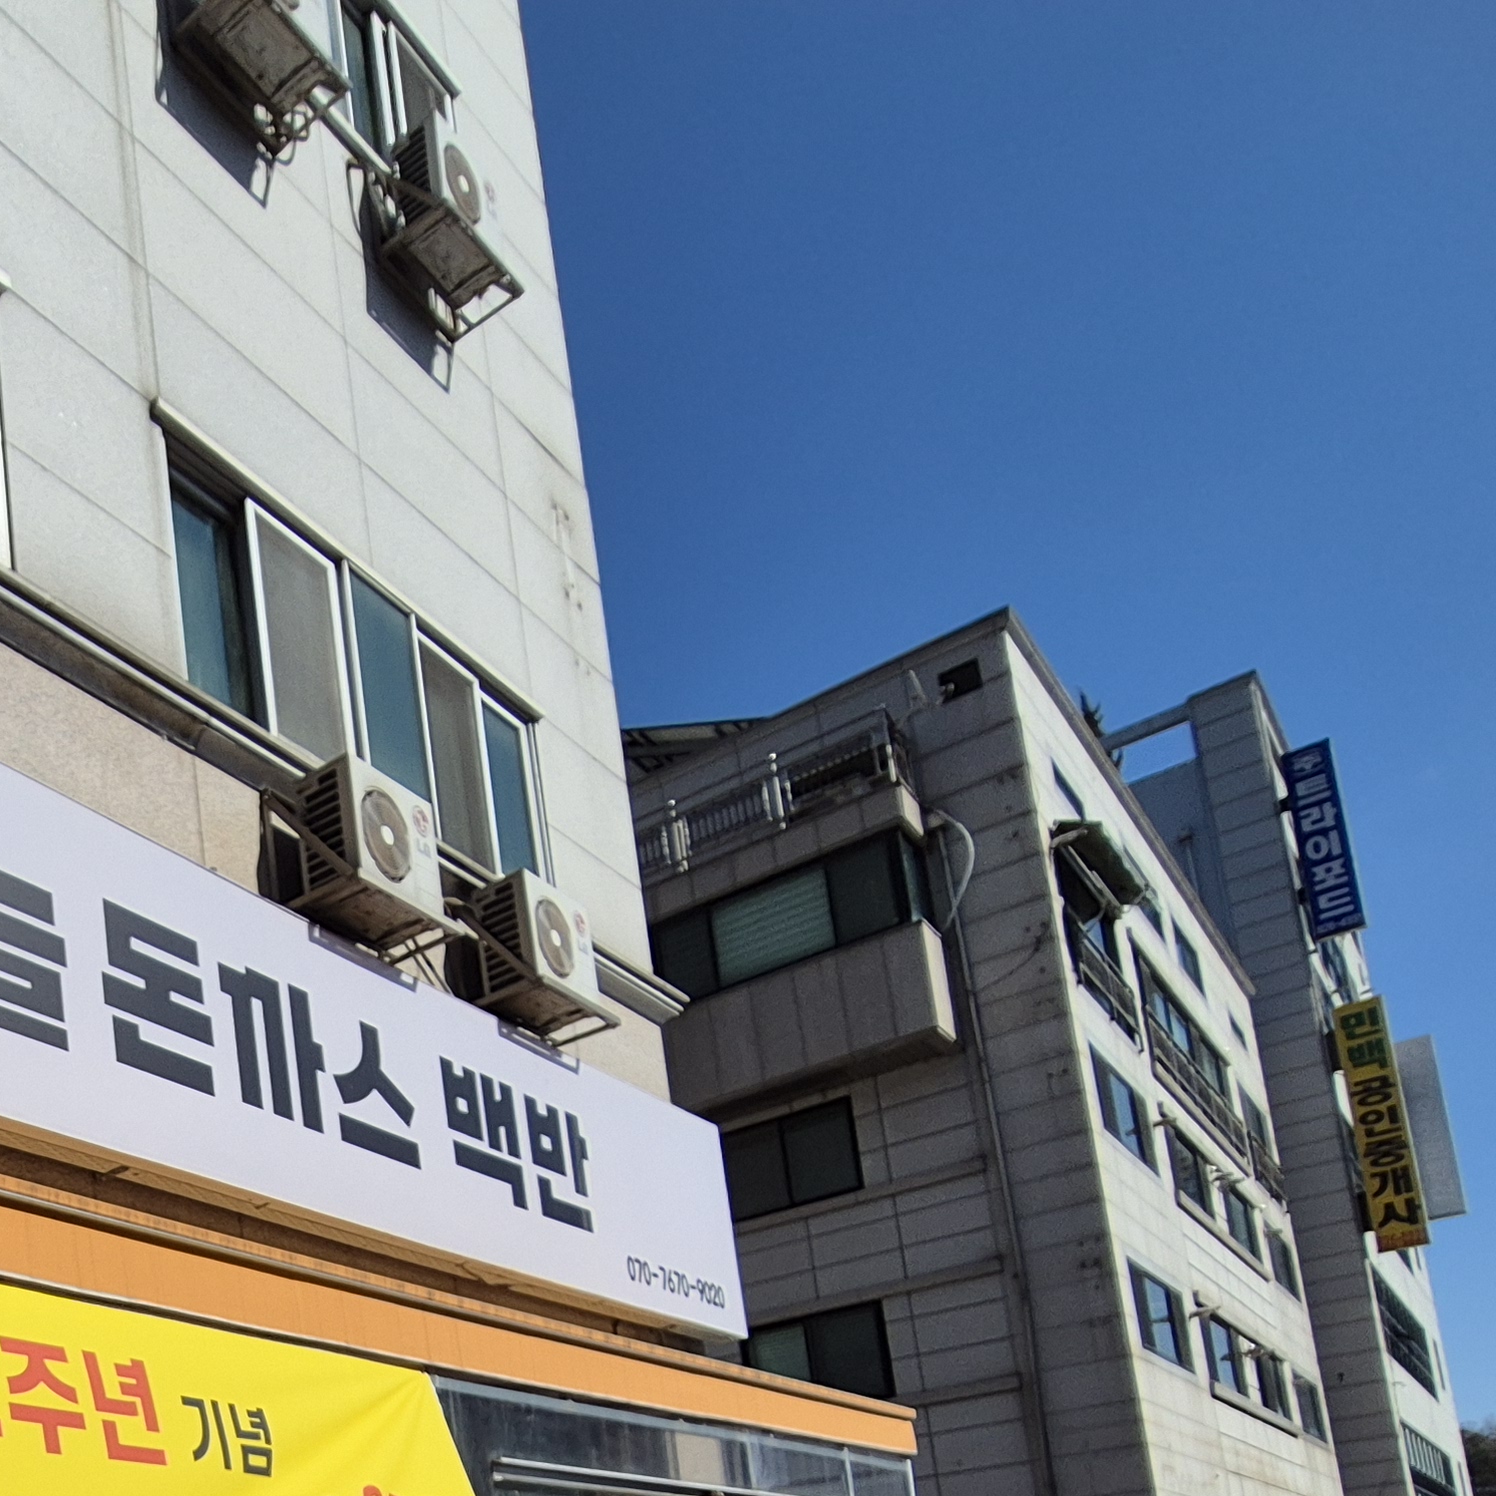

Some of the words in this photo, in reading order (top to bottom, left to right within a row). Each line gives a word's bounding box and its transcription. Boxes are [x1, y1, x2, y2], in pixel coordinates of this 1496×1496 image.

[100, 897, 422, 1171] 돈까스
[439, 1054, 595, 1234] 백반
[1351, 1075, 1421, 1229] 공인중개사
[626, 1254, 726, 1309] 070-7670-9020
[180, 1395, 273, 1478] 기념
